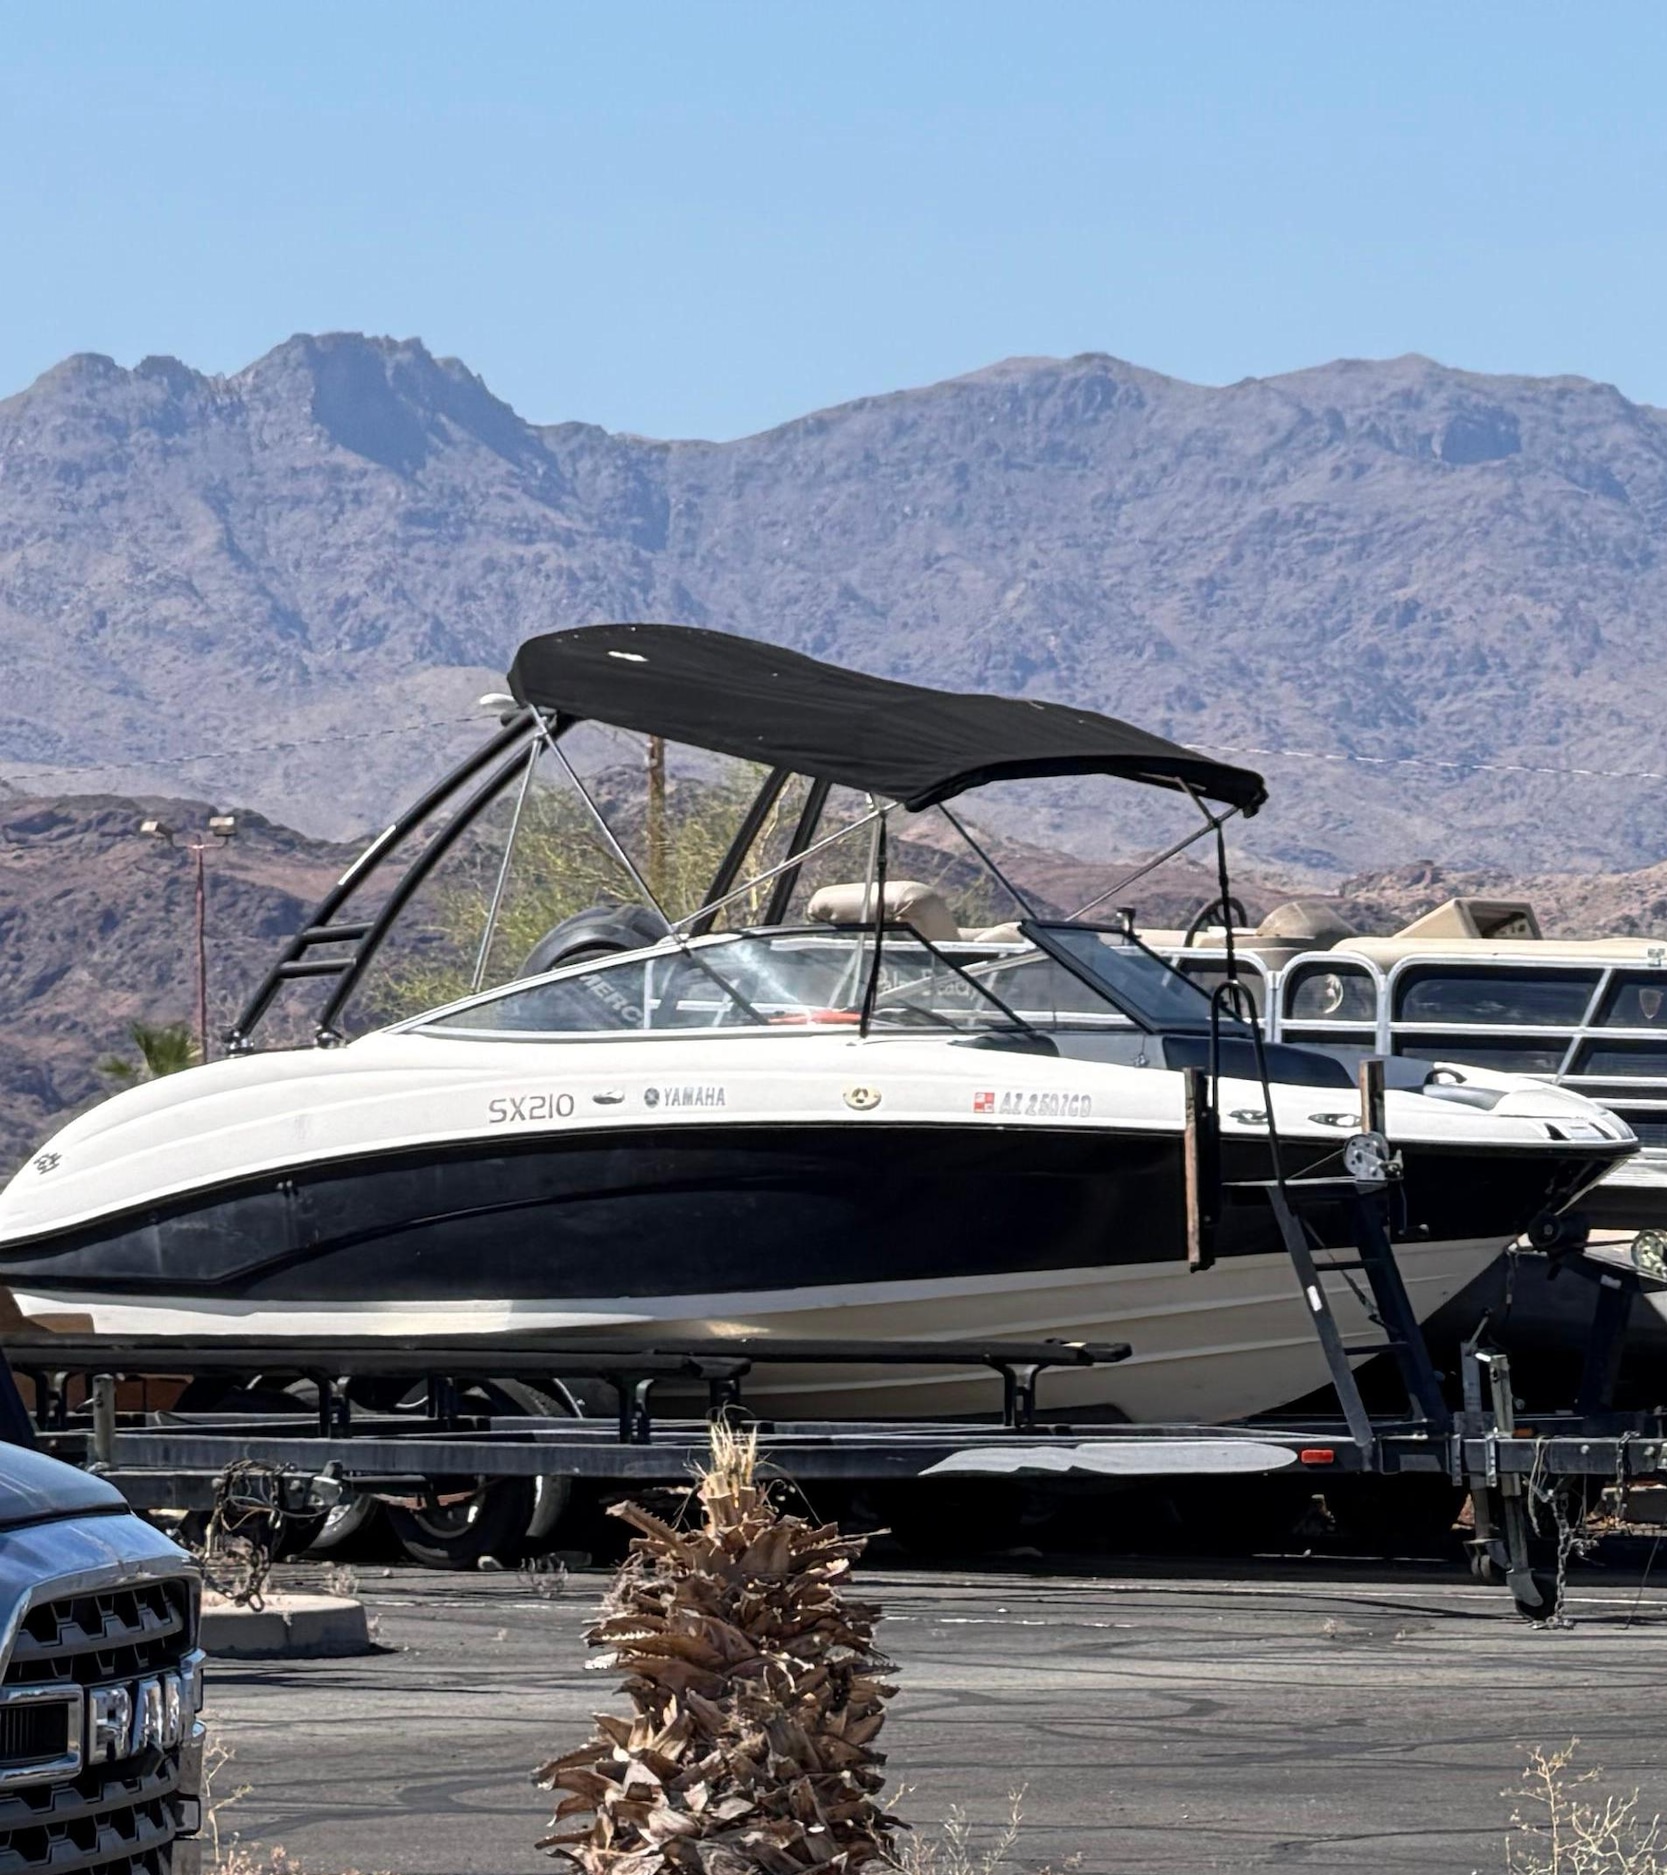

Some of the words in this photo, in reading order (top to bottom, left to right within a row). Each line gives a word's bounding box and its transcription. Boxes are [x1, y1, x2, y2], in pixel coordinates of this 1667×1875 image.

[579, 974, 645, 1028] MERC
[488, 1093, 575, 1124] SX210
[664, 1087, 726, 1107] YAMAHA
